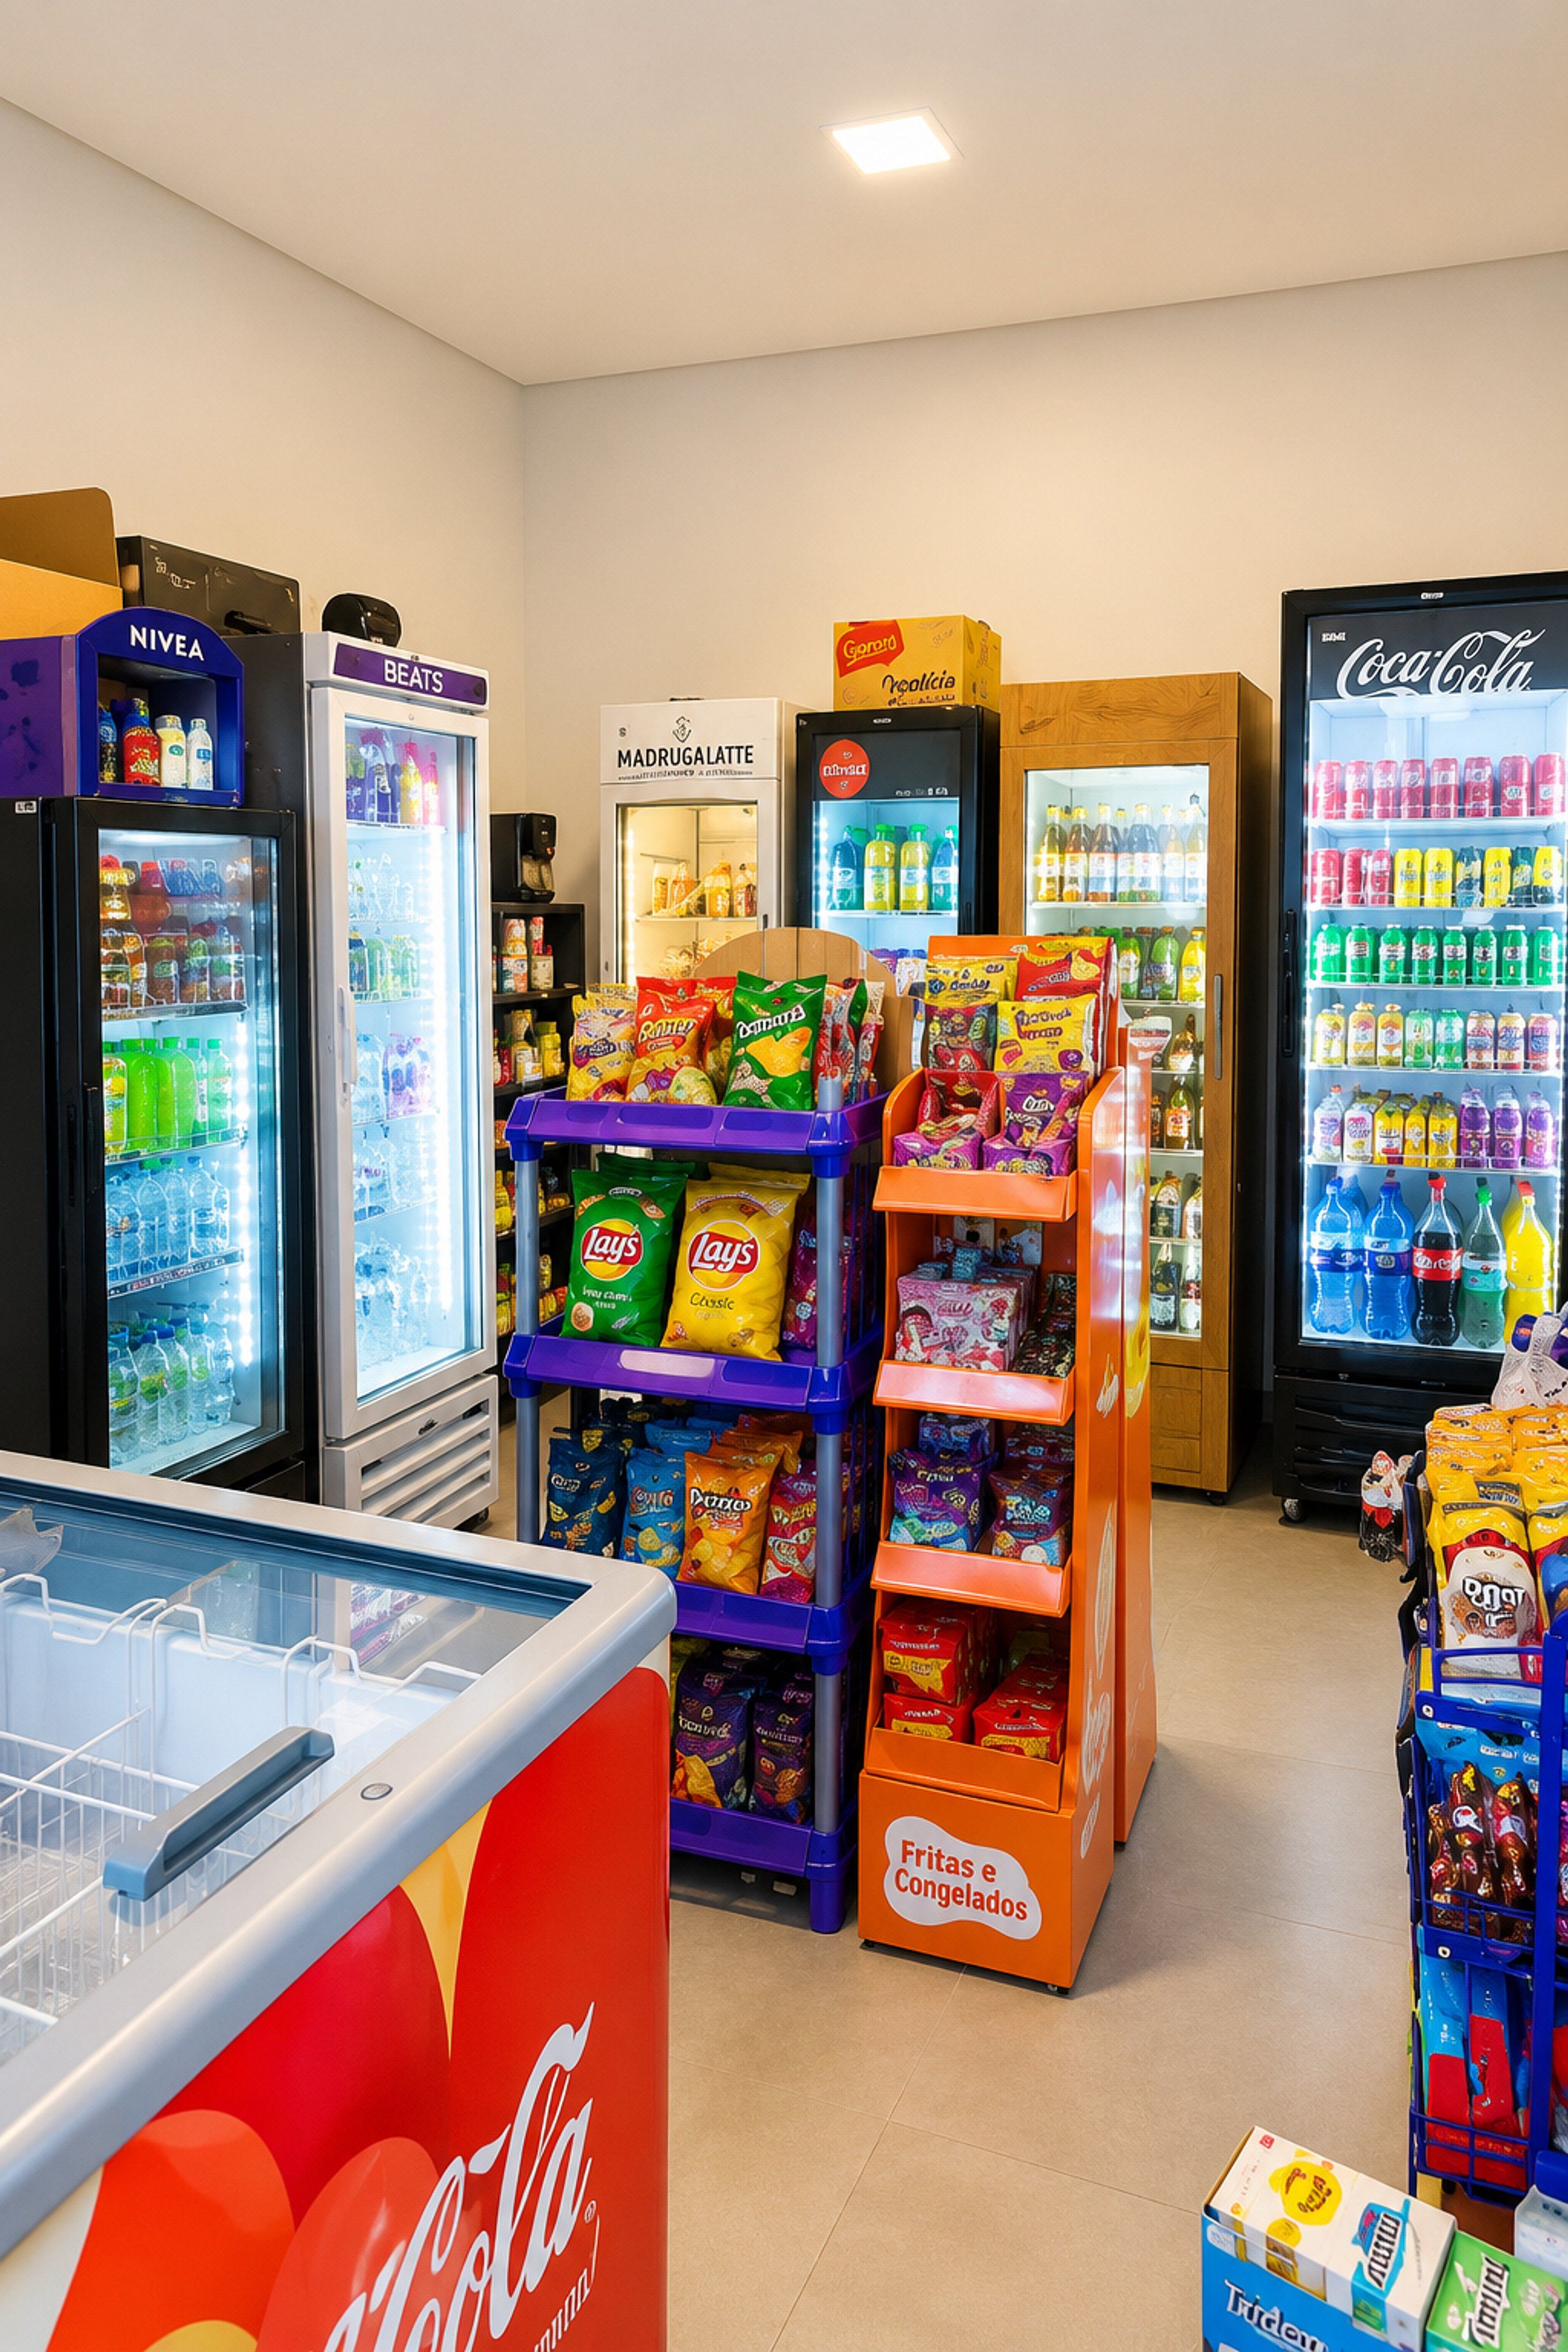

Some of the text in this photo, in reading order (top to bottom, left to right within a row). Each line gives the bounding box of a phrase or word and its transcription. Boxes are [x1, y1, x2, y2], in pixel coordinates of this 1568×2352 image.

[129, 624, 205, 662] NIVEA
[383, 660, 443, 693] BEATS
[1337, 629, 1546, 699] Coca-Cola
[617, 745, 754, 768] MADRUGALATTE
[584, 1226, 639, 1264] Lay's
[692, 1232, 755, 1272] Lay's
[902, 1839, 997, 1882] Fritas e
[894, 1868, 1028, 1921] Congelados
